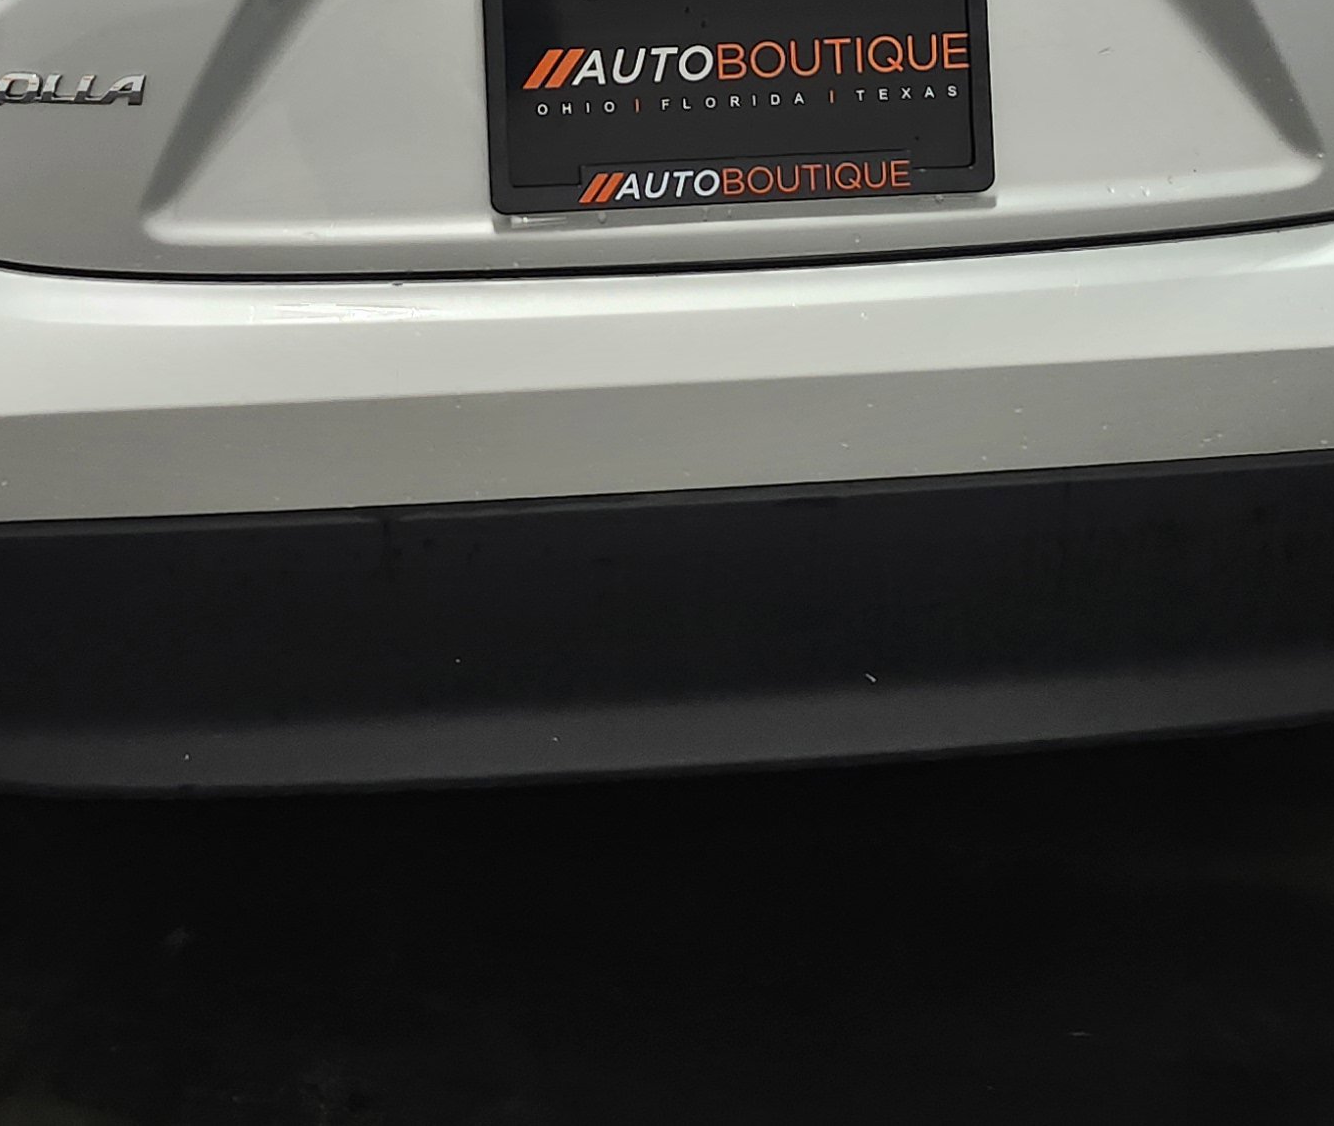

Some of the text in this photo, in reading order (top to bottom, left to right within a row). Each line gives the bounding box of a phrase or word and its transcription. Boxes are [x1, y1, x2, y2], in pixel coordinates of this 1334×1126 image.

[570, 32, 970, 87] AUTOBOUTIQUE
[536, 85, 958, 116] OHIO FLORIDA TEXAS
[615, 159, 912, 201] AUTOBOUTIQUE
